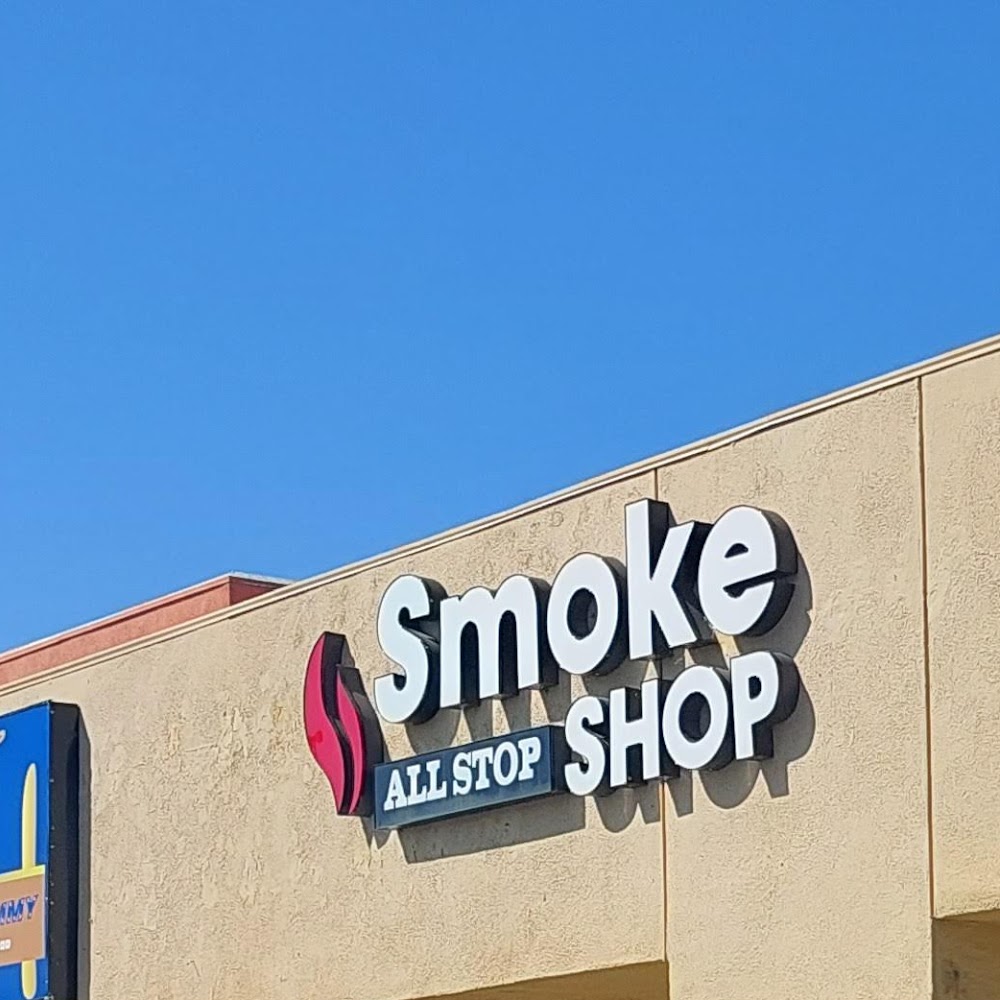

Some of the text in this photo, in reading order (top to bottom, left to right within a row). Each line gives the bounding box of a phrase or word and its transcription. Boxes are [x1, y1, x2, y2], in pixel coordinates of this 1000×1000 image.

[374, 498, 788, 724] Smoke
[382, 737, 542, 812] ALL STOP
[564, 651, 788, 797] SHOP
